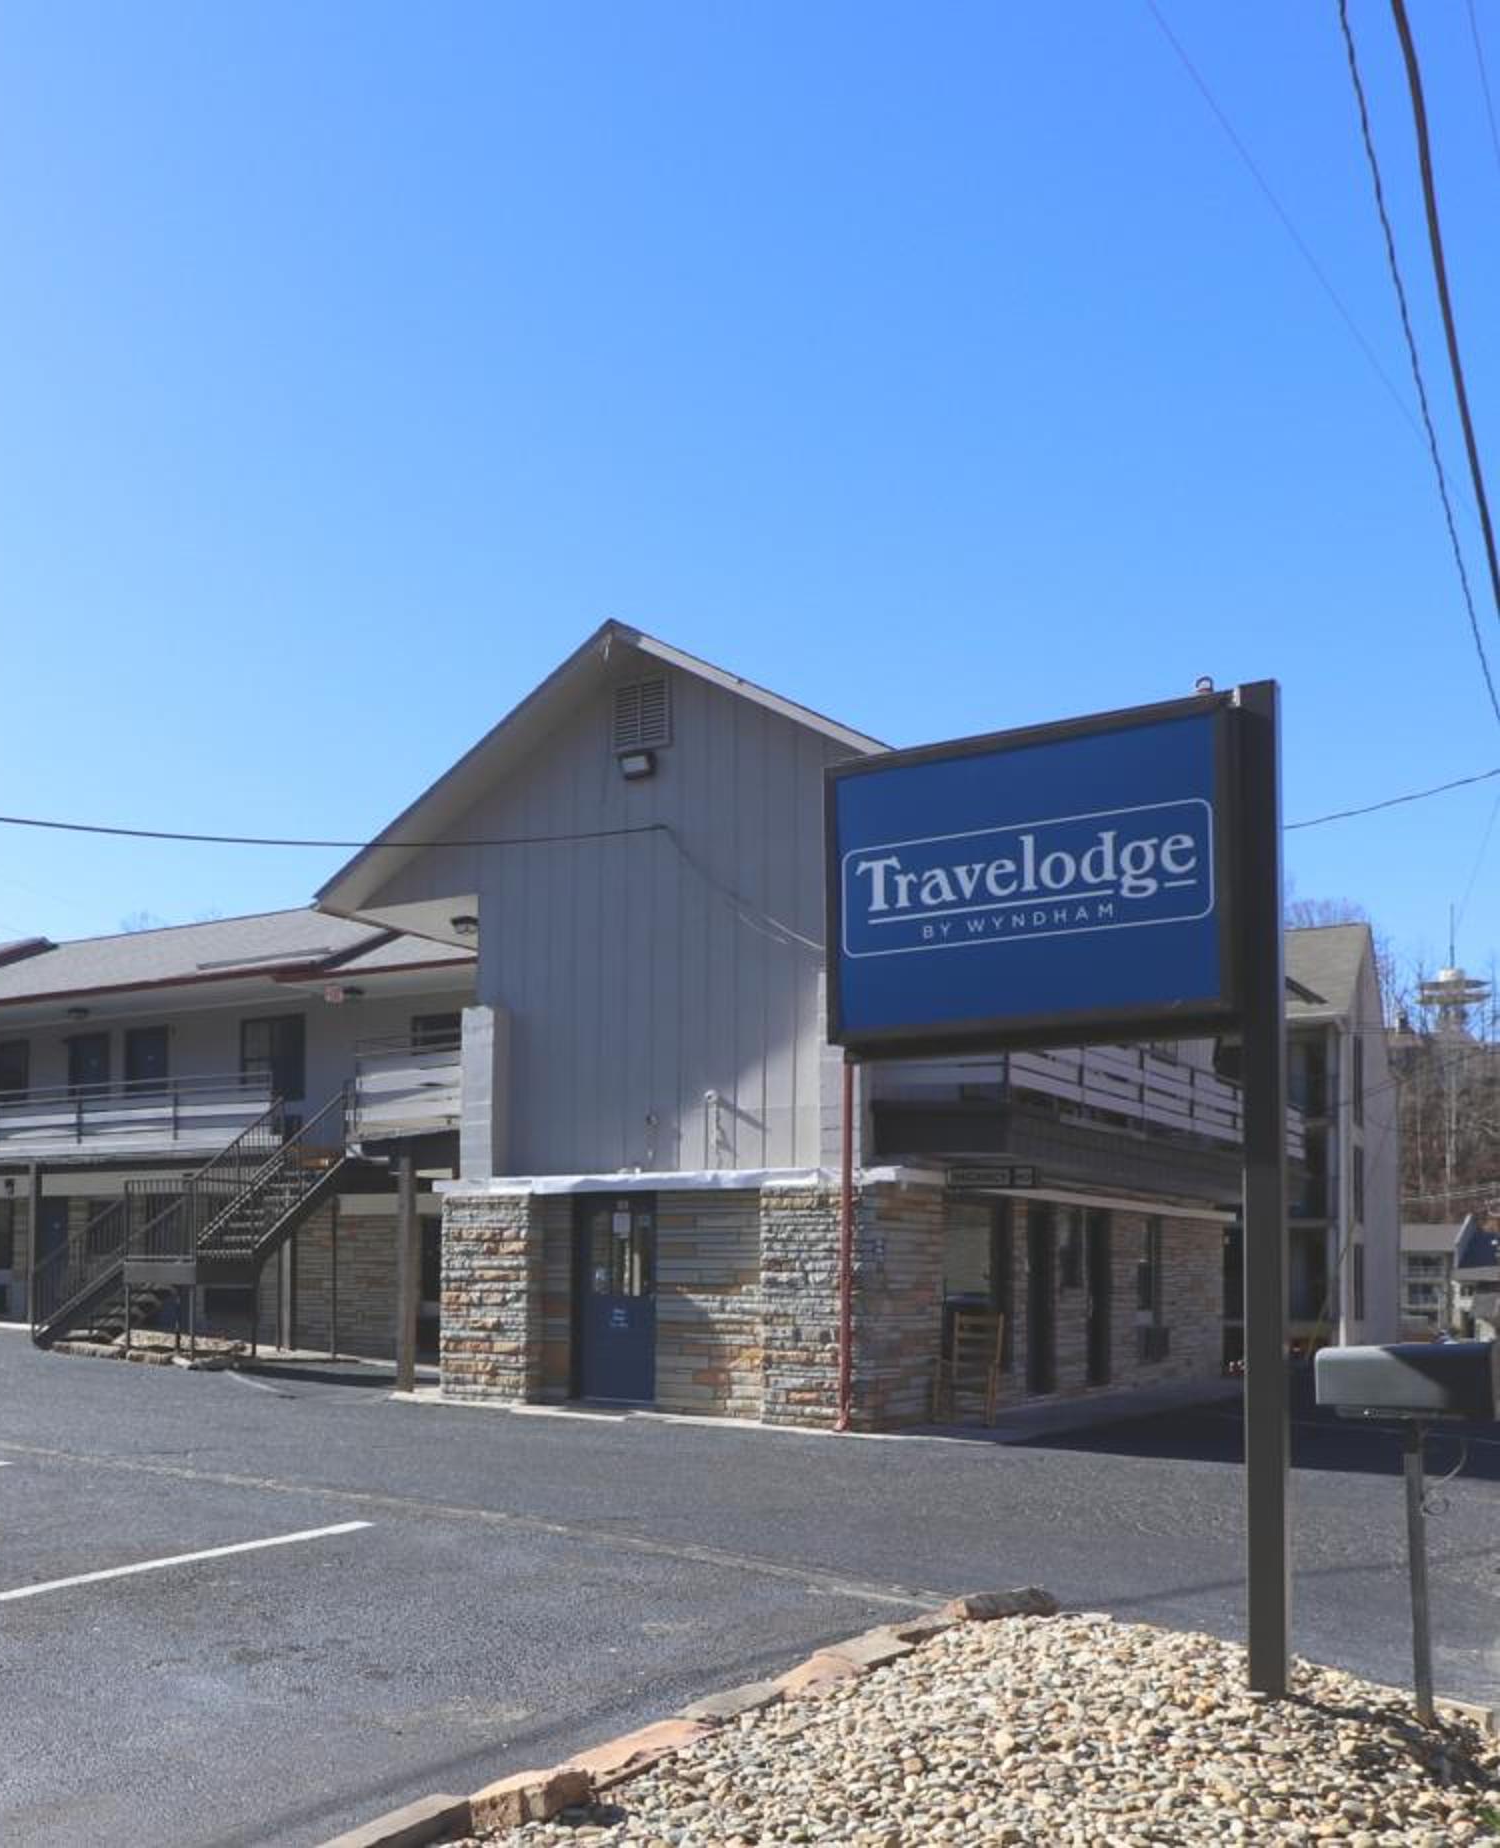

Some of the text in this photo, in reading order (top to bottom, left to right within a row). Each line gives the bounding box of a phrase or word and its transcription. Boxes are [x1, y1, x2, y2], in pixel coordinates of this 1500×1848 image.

[856, 831, 1197, 912] Travelodge
[922, 903, 1114, 940] BY WYNDHAM
